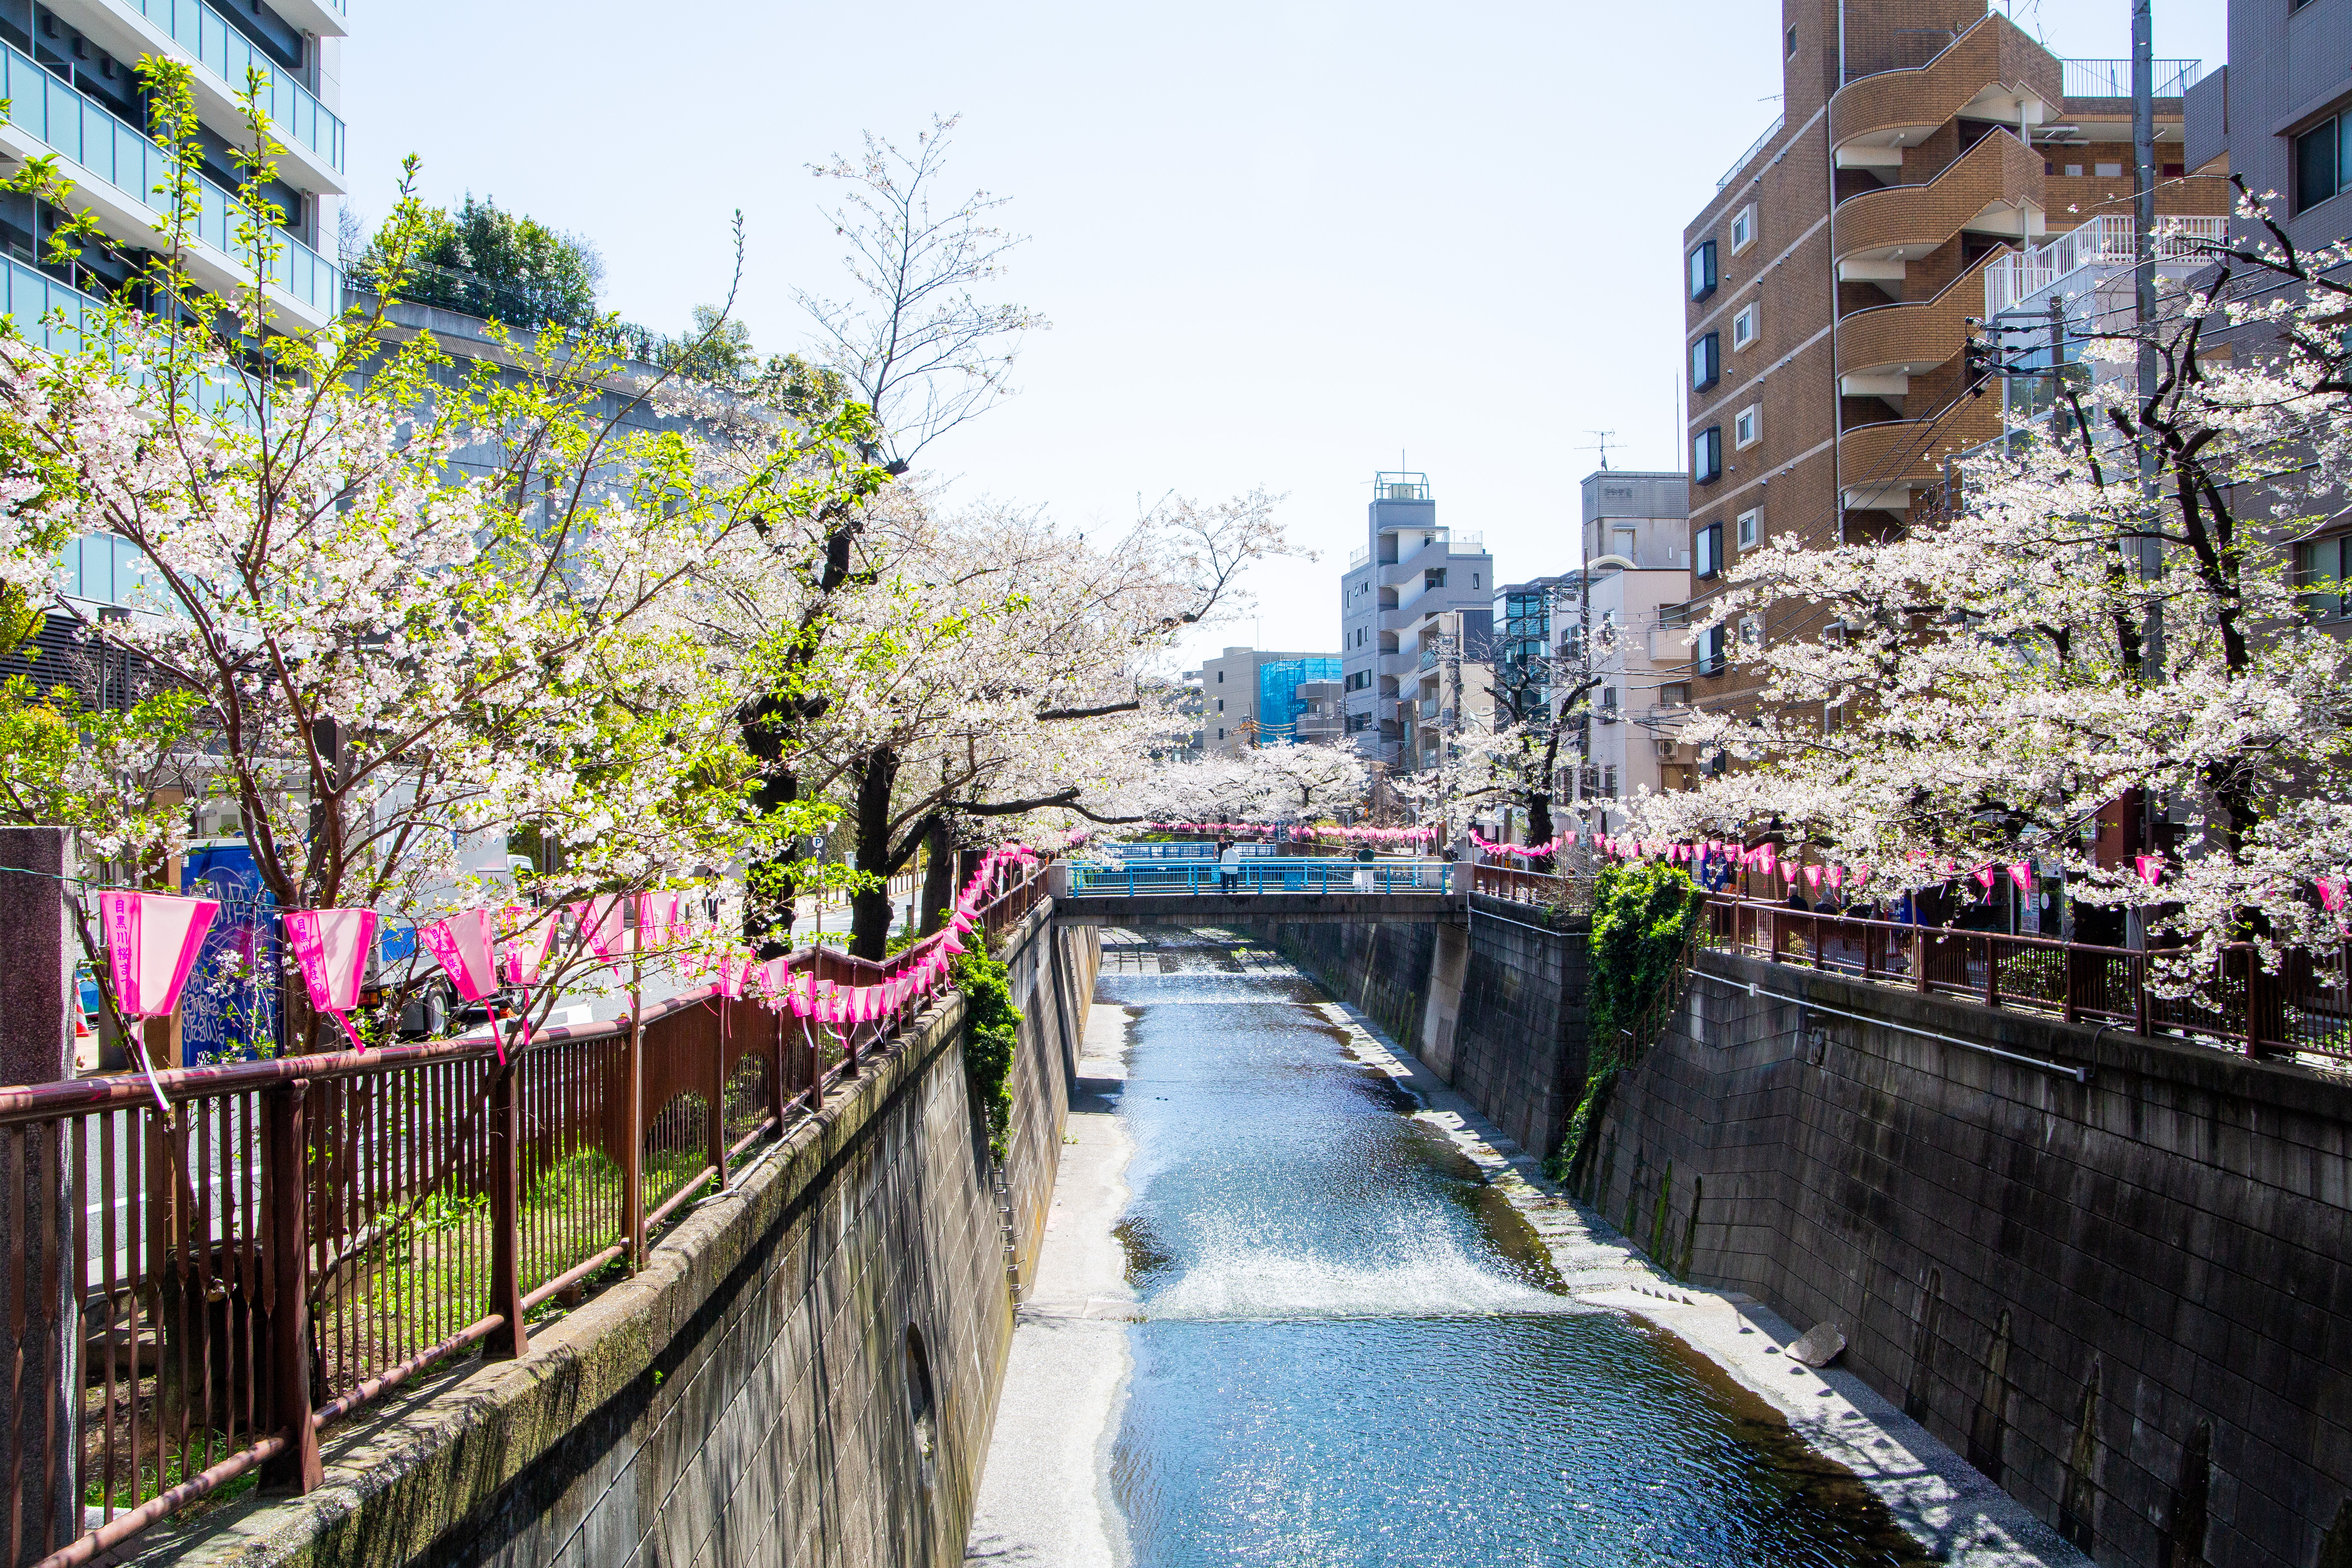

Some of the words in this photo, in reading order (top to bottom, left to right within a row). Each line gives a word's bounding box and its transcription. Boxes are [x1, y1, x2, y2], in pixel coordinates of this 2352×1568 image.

[116, 900, 131, 1005] 目黒川桜まつり
[297, 919, 323, 1005] 目黒川桜まつり
[430, 929, 471, 996] 目黒川桜まつり
